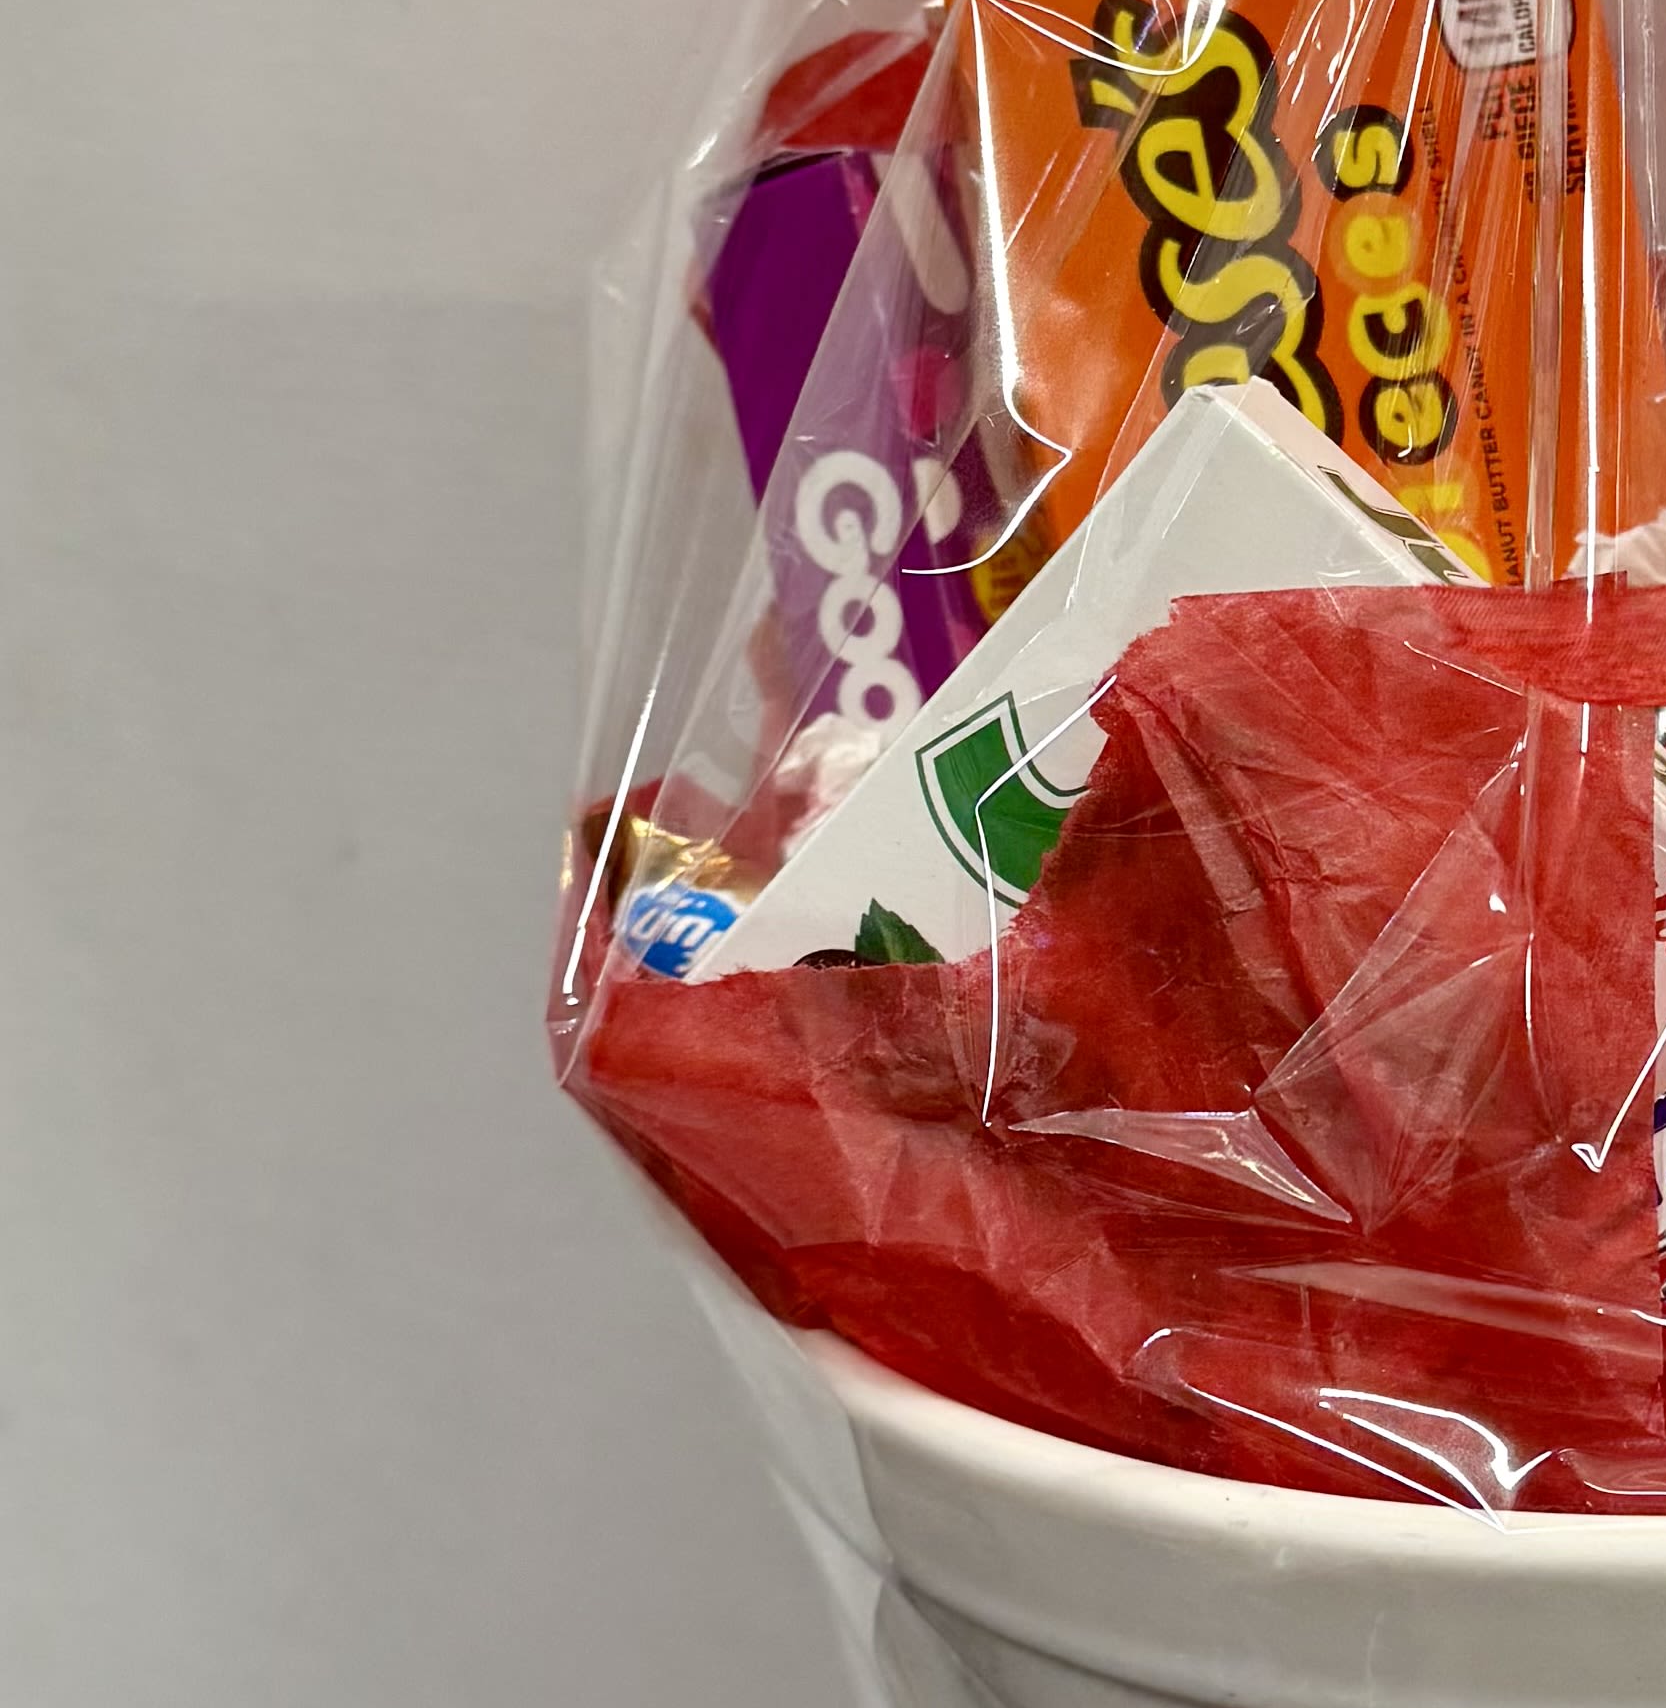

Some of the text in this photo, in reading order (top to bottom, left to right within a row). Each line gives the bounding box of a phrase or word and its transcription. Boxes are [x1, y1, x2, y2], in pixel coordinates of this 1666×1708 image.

[1417, 99, 1443, 170] SHELL
[1460, 313, 1475, 337] IN
[1465, 344, 1493, 421] CANDY
[1479, 426, 1510, 513] BUTTER
[796, 450, 923, 740] Goo
